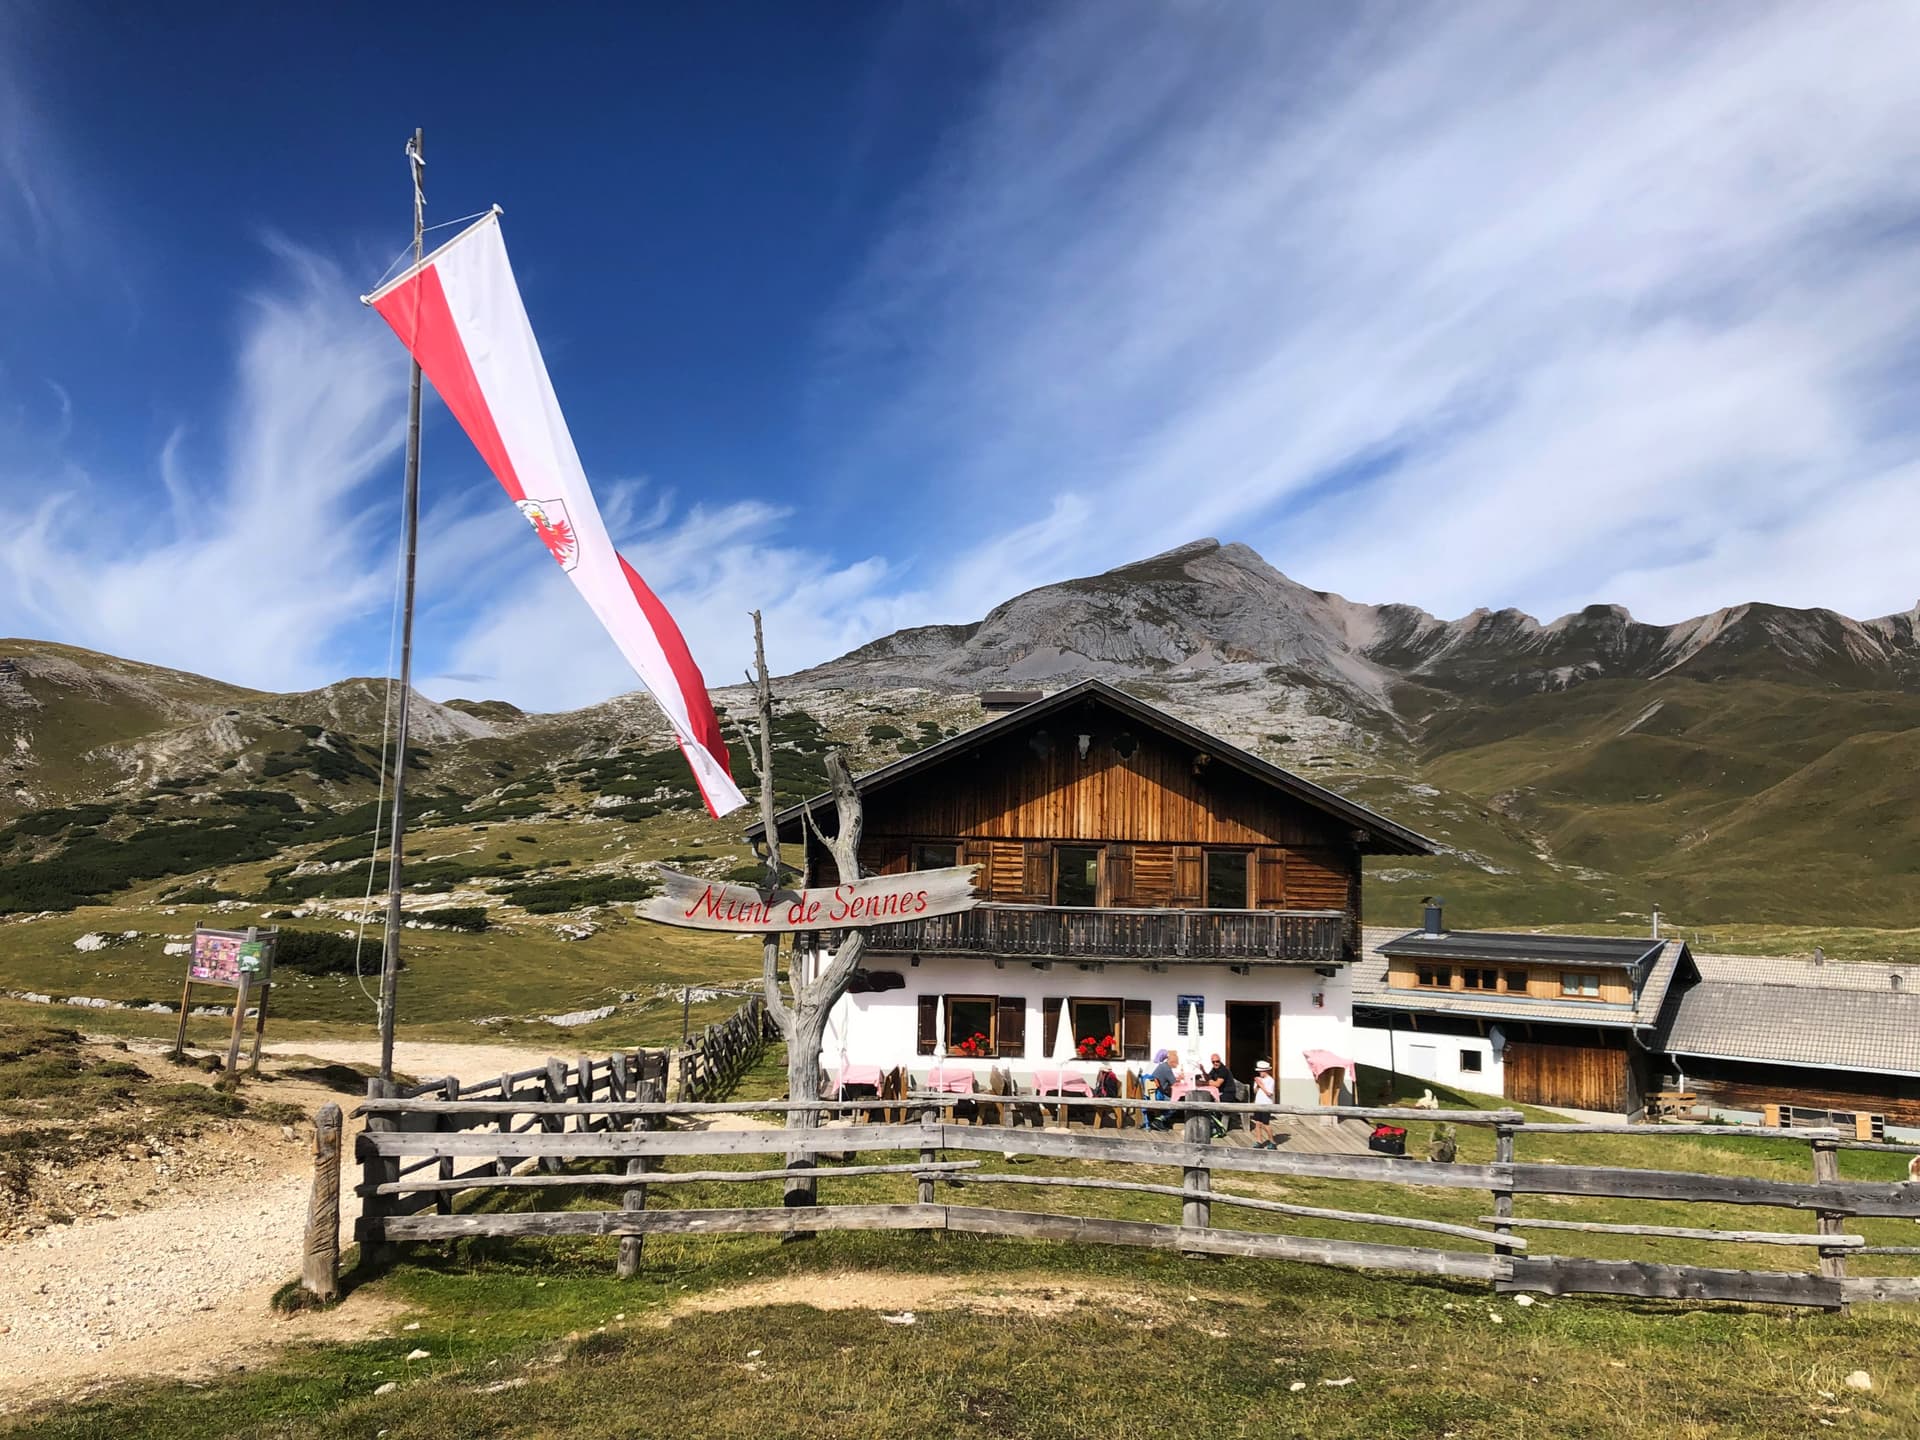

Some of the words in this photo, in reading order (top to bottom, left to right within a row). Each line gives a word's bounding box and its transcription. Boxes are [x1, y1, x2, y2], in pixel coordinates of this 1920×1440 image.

[685, 884, 775, 924] Munt
[787, 891, 821, 925] de
[829, 885, 929, 921] Sennes
